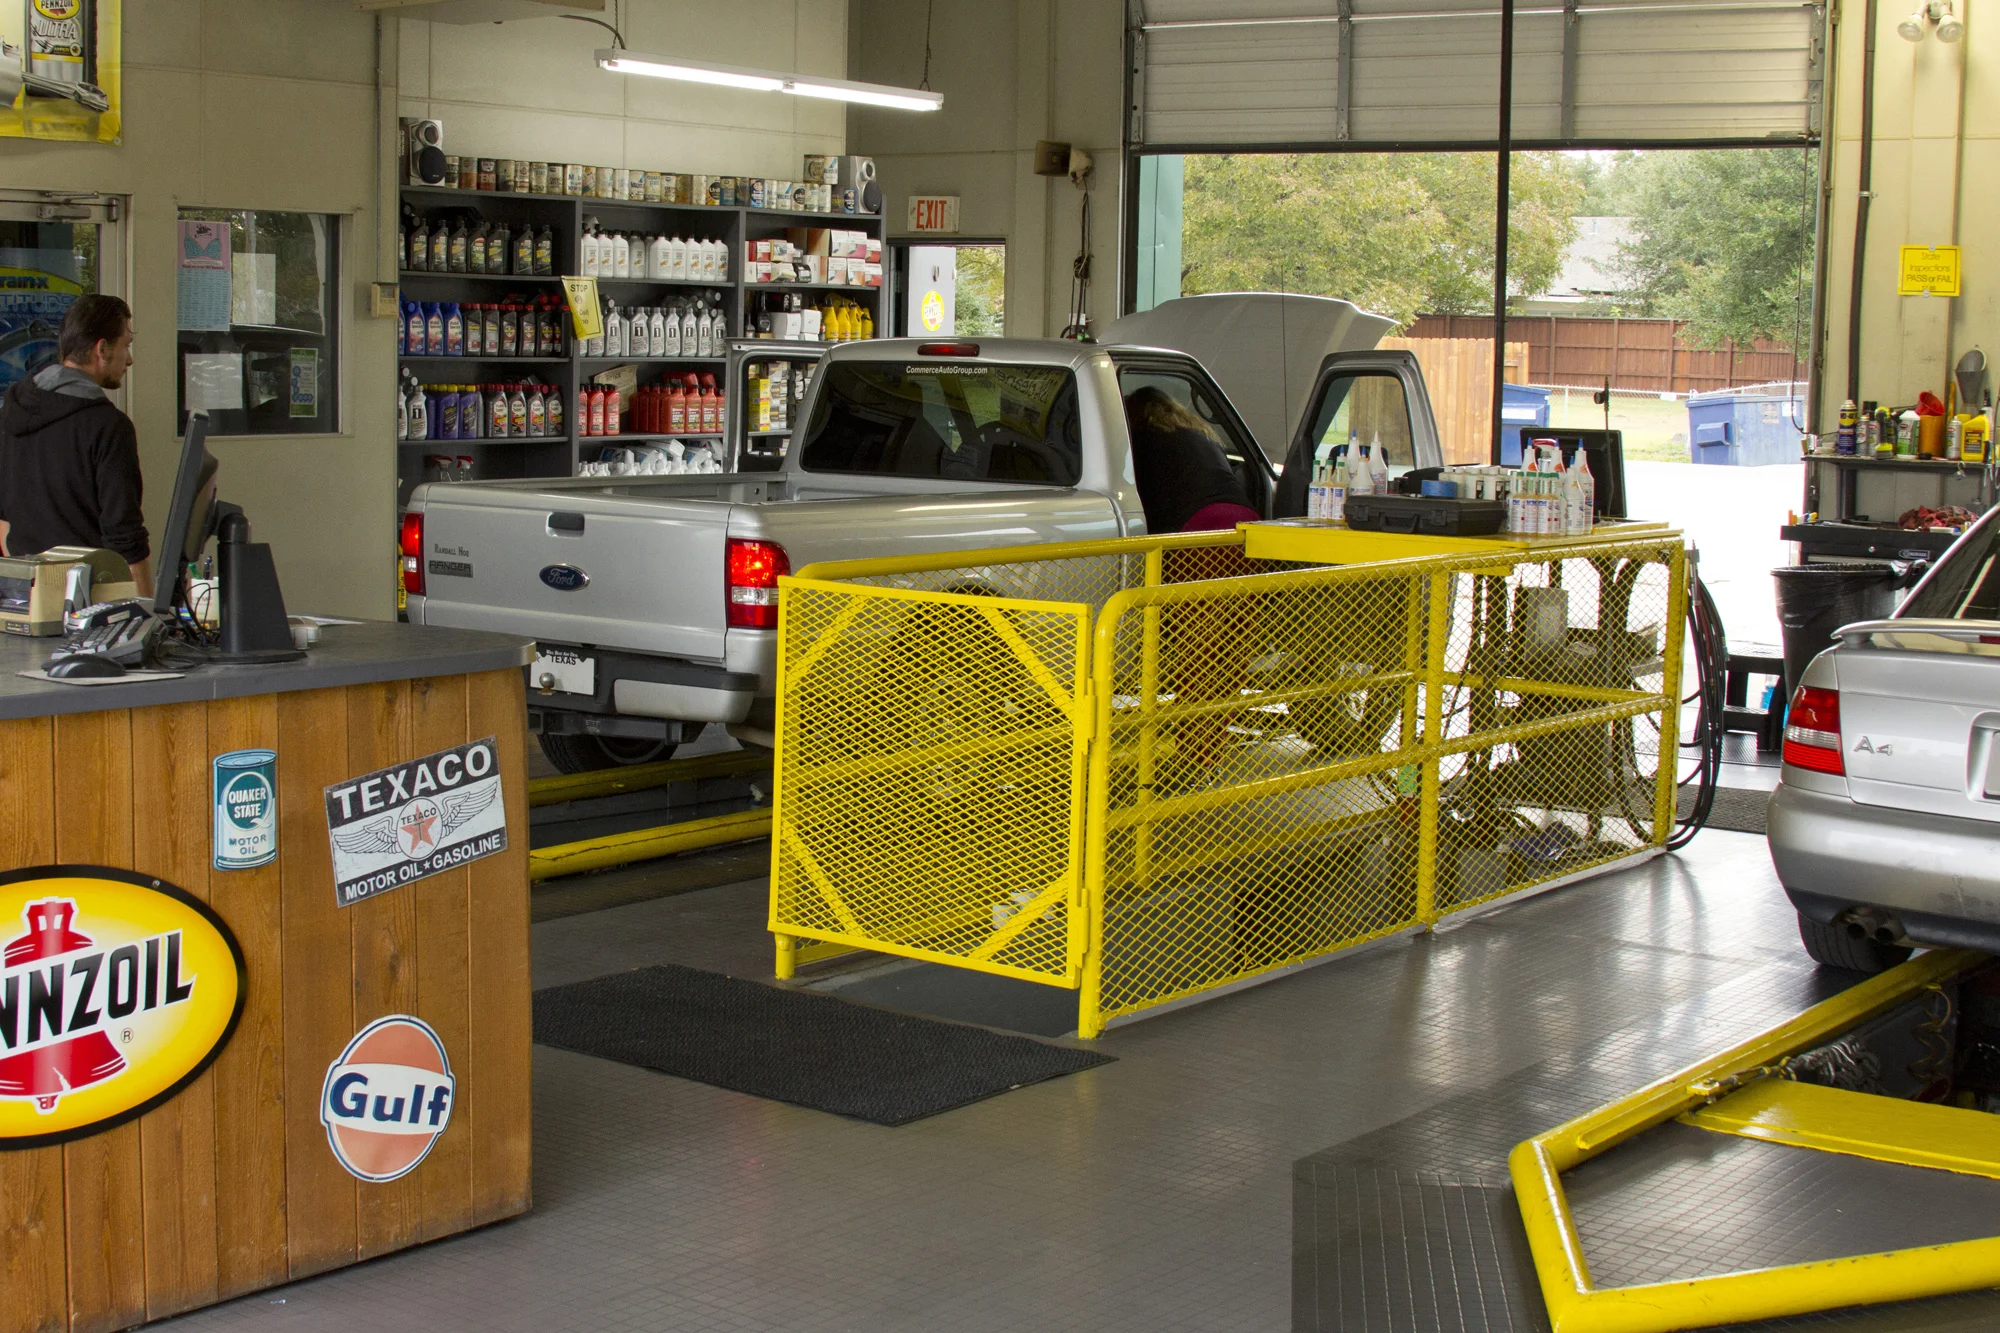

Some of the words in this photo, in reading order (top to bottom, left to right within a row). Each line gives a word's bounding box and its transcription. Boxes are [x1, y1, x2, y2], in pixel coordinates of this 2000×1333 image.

[40, 20, 76, 39] ULTRA
[916, 200, 947, 230] EXIT
[1909, 264, 1951, 273] Inspections
[1906, 274, 1928, 283] PASS
[1937, 274, 1953, 283] FAIL
[570, 284, 588, 293] STOP
[906, 366, 988, 375] CommerceAutoGroup.com
[429, 560, 471, 573] RANGER
[547, 568, 576, 586] Ford
[551, 655, 576, 666] TEXAS
[1853, 735, 1893, 757] A4
[332, 744, 492, 820] TEXACO
[228, 787, 267, 804] QUAKER
[233, 803, 261, 819] STATE
[401, 807, 437, 826] TEXACO
[228, 834, 267, 847] MOTOR
[239, 846, 257, 855] OIL
[344, 870, 397, 901] MOTOR
[399, 862, 423, 881] OIL
[432, 834, 502, 869] GASOLINE
[329, 1072, 451, 1127] Gulf
